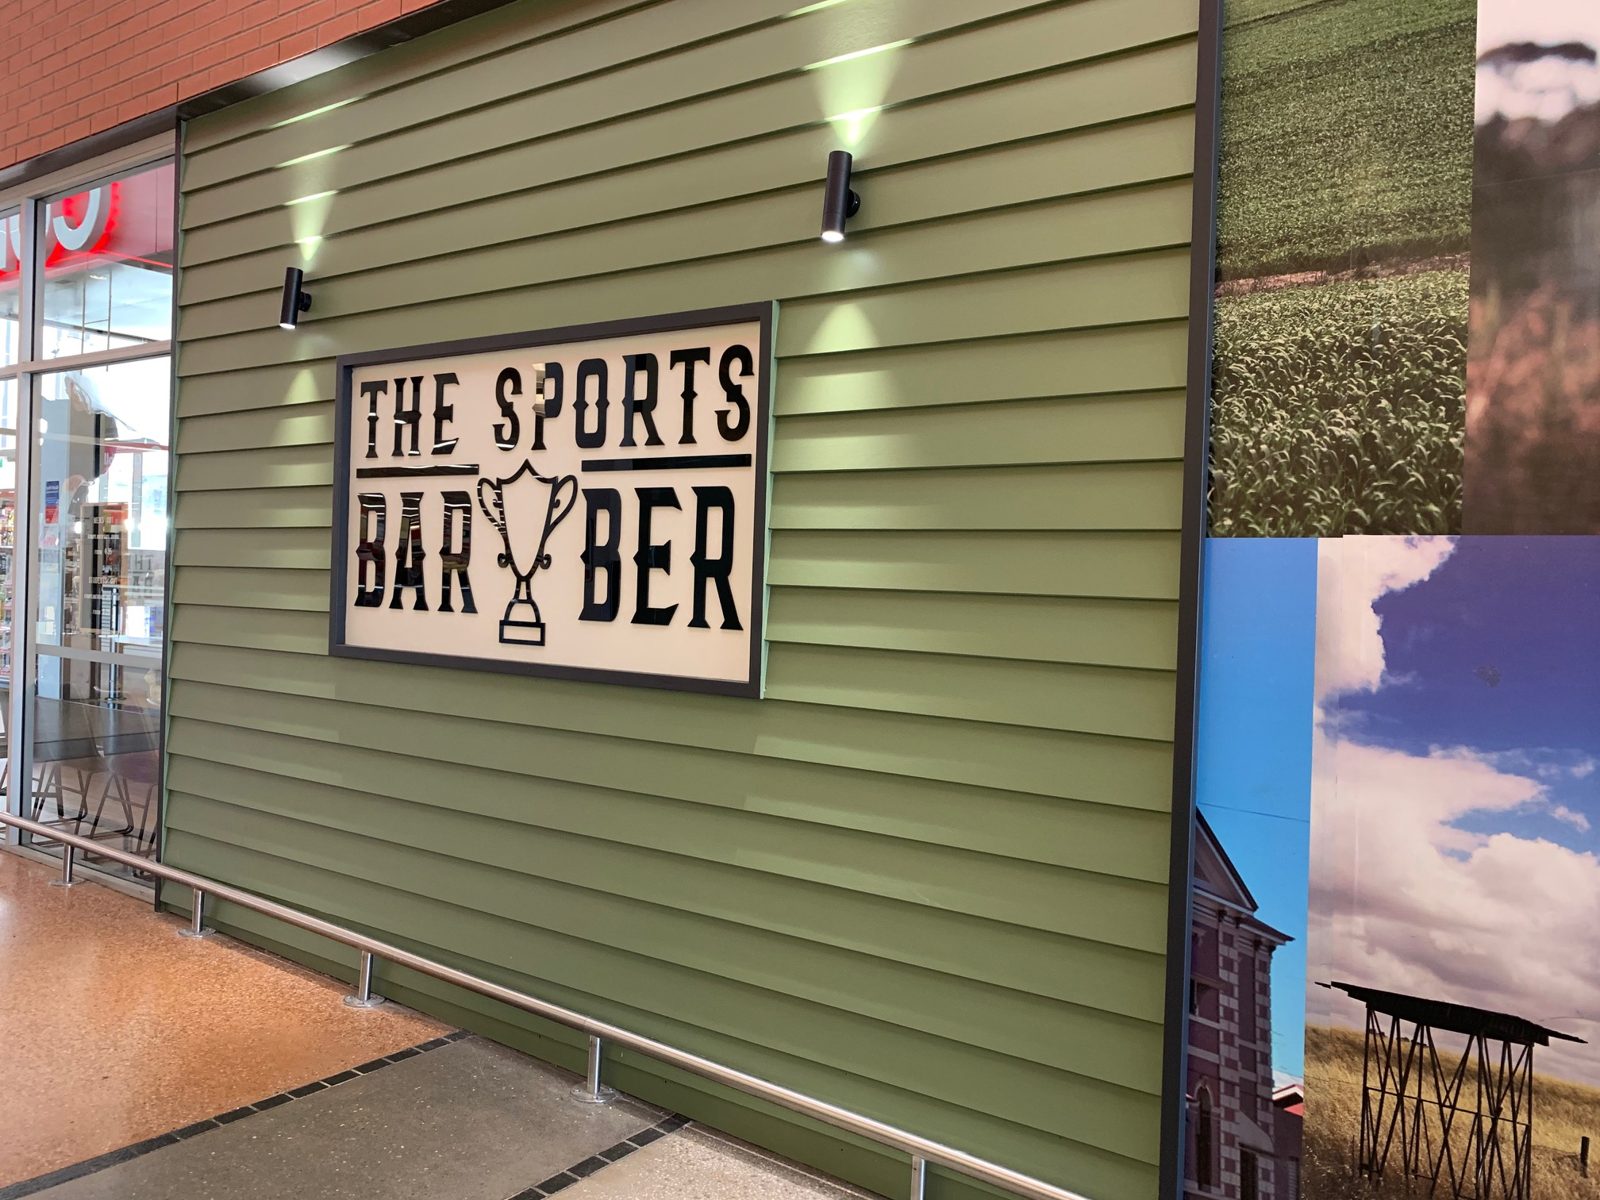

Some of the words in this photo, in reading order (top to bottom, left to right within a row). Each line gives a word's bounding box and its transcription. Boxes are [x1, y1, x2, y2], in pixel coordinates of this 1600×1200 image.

[360, 373, 460, 458] THE
[493, 344, 755, 451] SPORTS
[354, 491, 478, 613] BAR
[579, 486, 744, 631] BER
